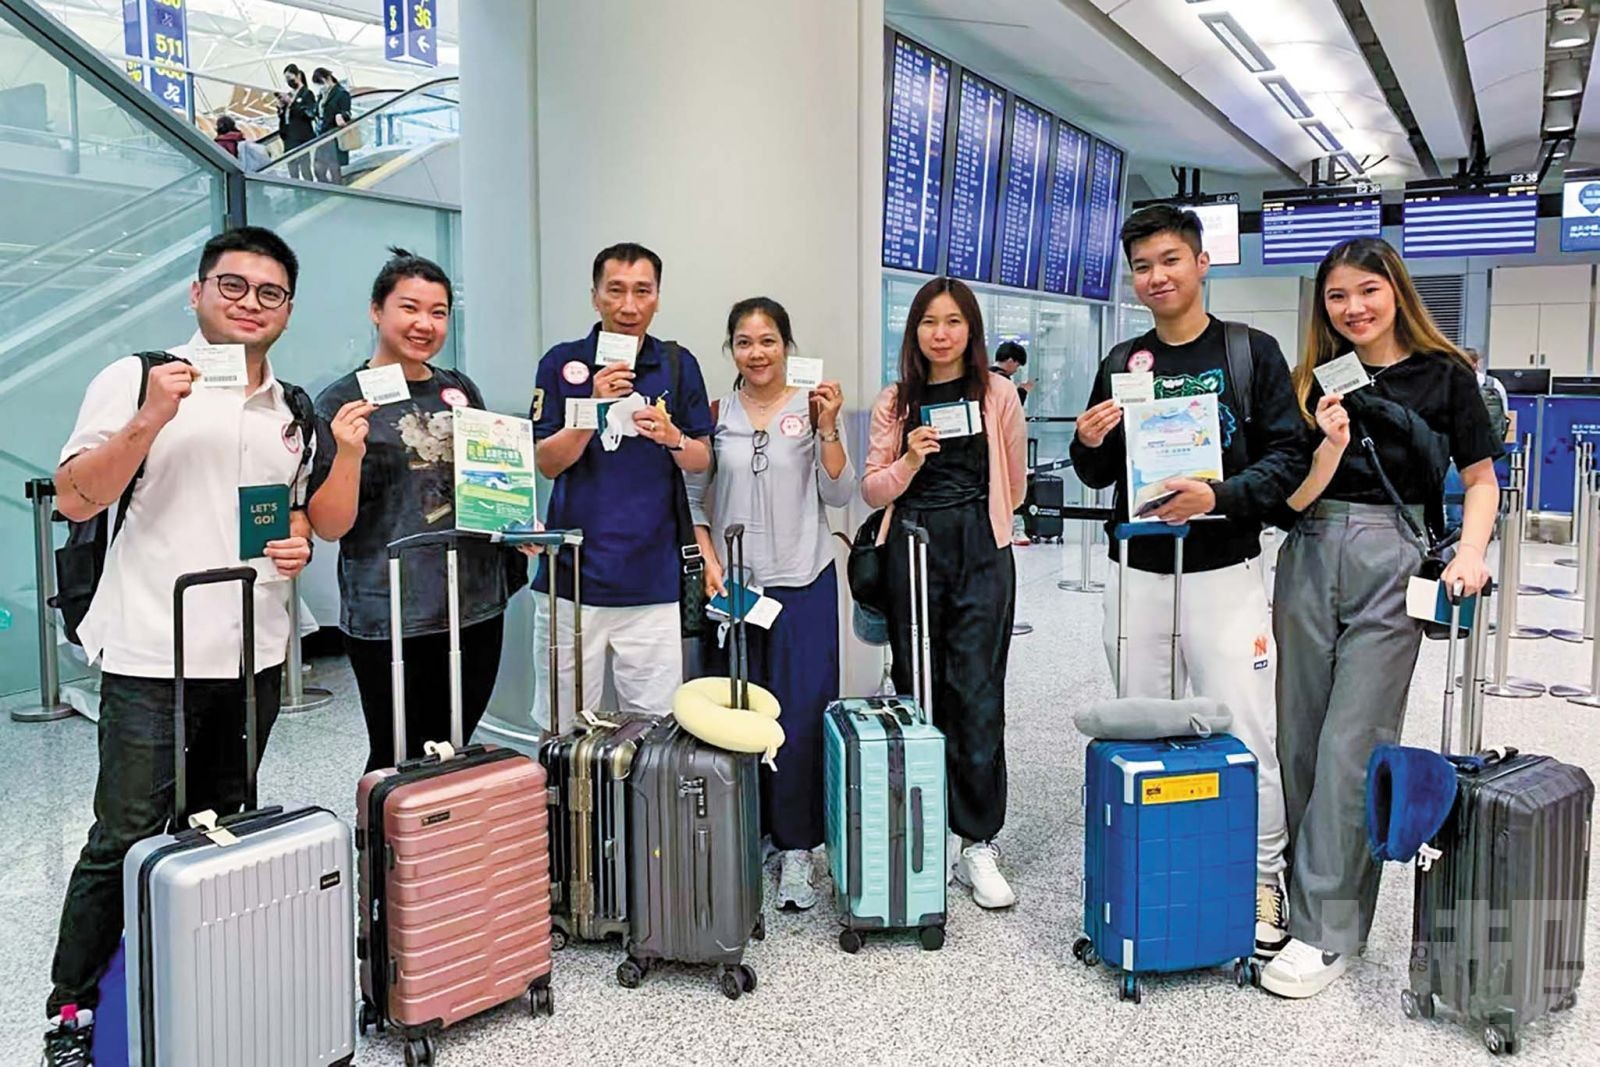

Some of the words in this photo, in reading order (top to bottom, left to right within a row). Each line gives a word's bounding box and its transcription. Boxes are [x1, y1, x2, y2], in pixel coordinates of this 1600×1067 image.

[414, 5, 432, 30] 36
[155, 33, 182, 58] 511
[1511, 174, 1524, 183] E2
[250, 502, 278, 513] LET'S
[254, 515, 275, 525] GO!
